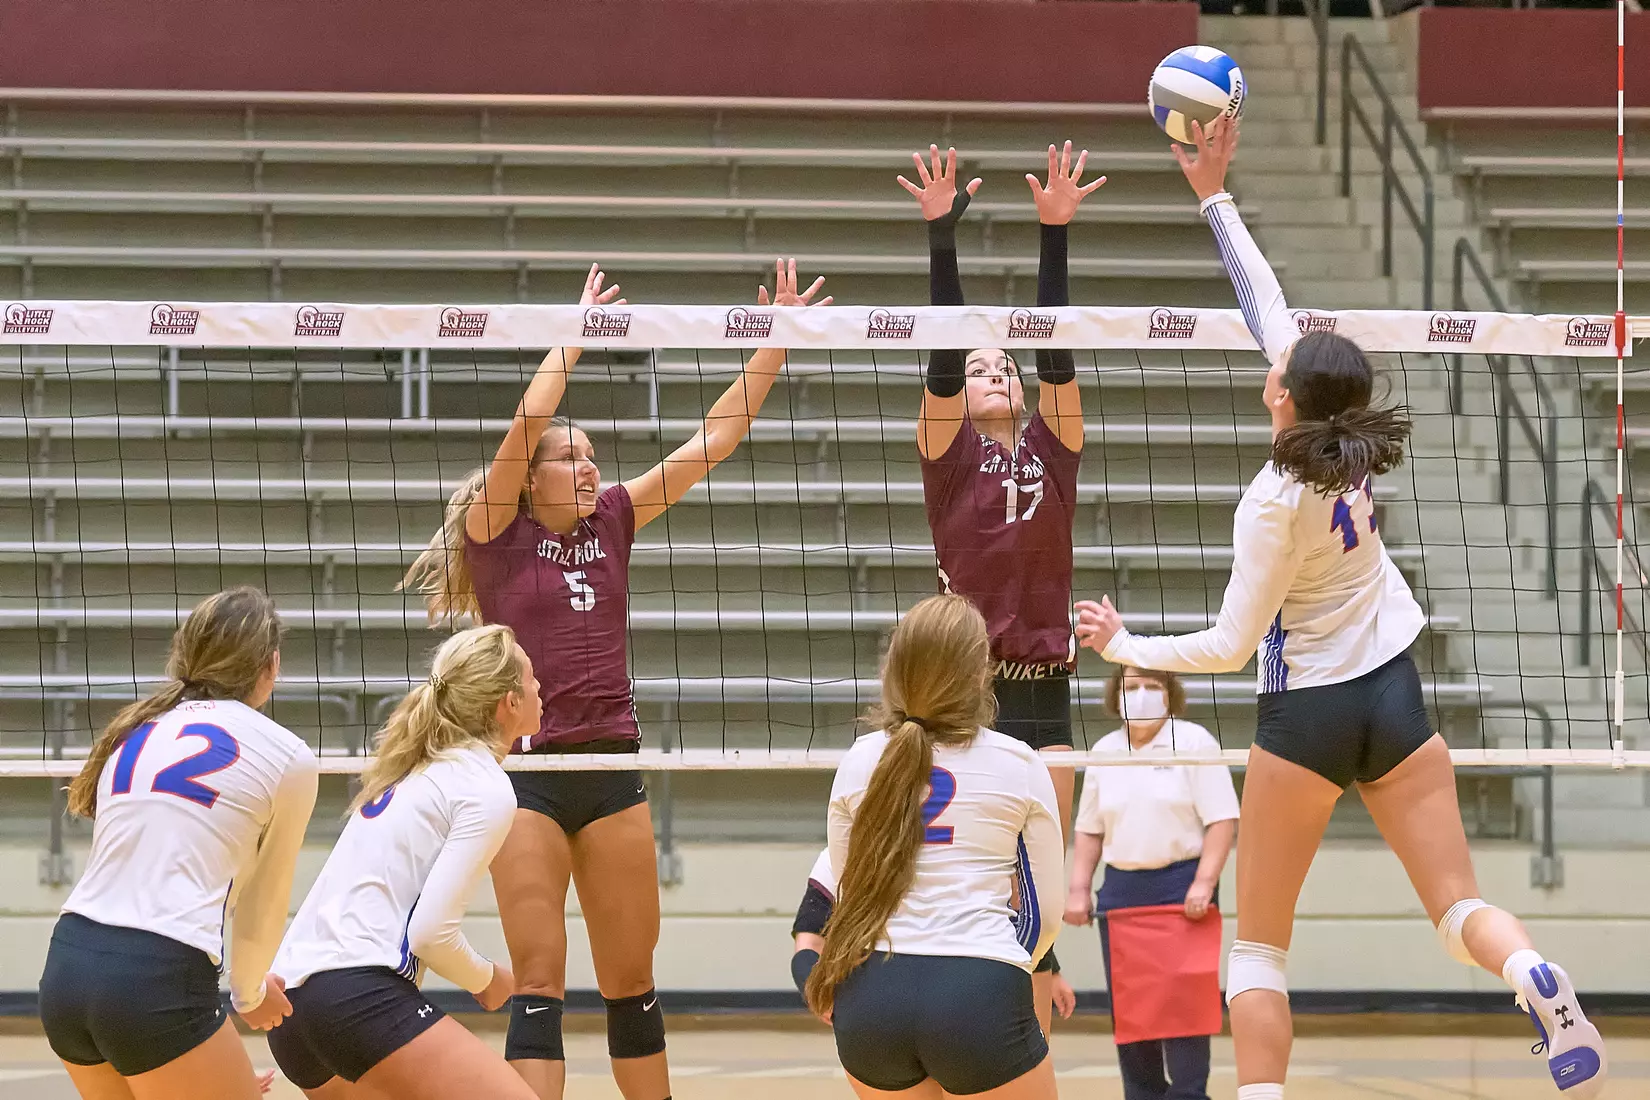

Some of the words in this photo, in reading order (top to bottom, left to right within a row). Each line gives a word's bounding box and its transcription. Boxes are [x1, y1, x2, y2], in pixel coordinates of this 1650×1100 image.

[1225, 80, 1242, 121] olten
[26, 310, 52, 318] LITTLE
[171, 311, 198, 319] LITTLE
[317, 312, 343, 321] LITTLE
[461, 314, 487, 322] LITTLE
[604, 314, 630, 322] LITTLE
[24, 317, 50, 325] ROCK
[169, 318, 195, 326] ROCK
[889, 315, 914, 323] LITTLE
[1030, 315, 1055, 323] LITTLE
[1171, 315, 1195, 323] LITTLE
[1311, 317, 1335, 325] LITTLE
[315, 320, 341, 328] ROCK
[887, 322, 912, 330] ROCK
[1028, 322, 1054, 330] ROCK
[1450, 319, 1475, 328] LITTLE
[1587, 323, 1611, 332] LITTLE
[1001, 478, 1044, 525] 17
[562, 570, 596, 612] 5
[994, 659, 1046, 681] NIKE
[110, 721, 241, 809] 12
[920, 765, 957, 845] 2
